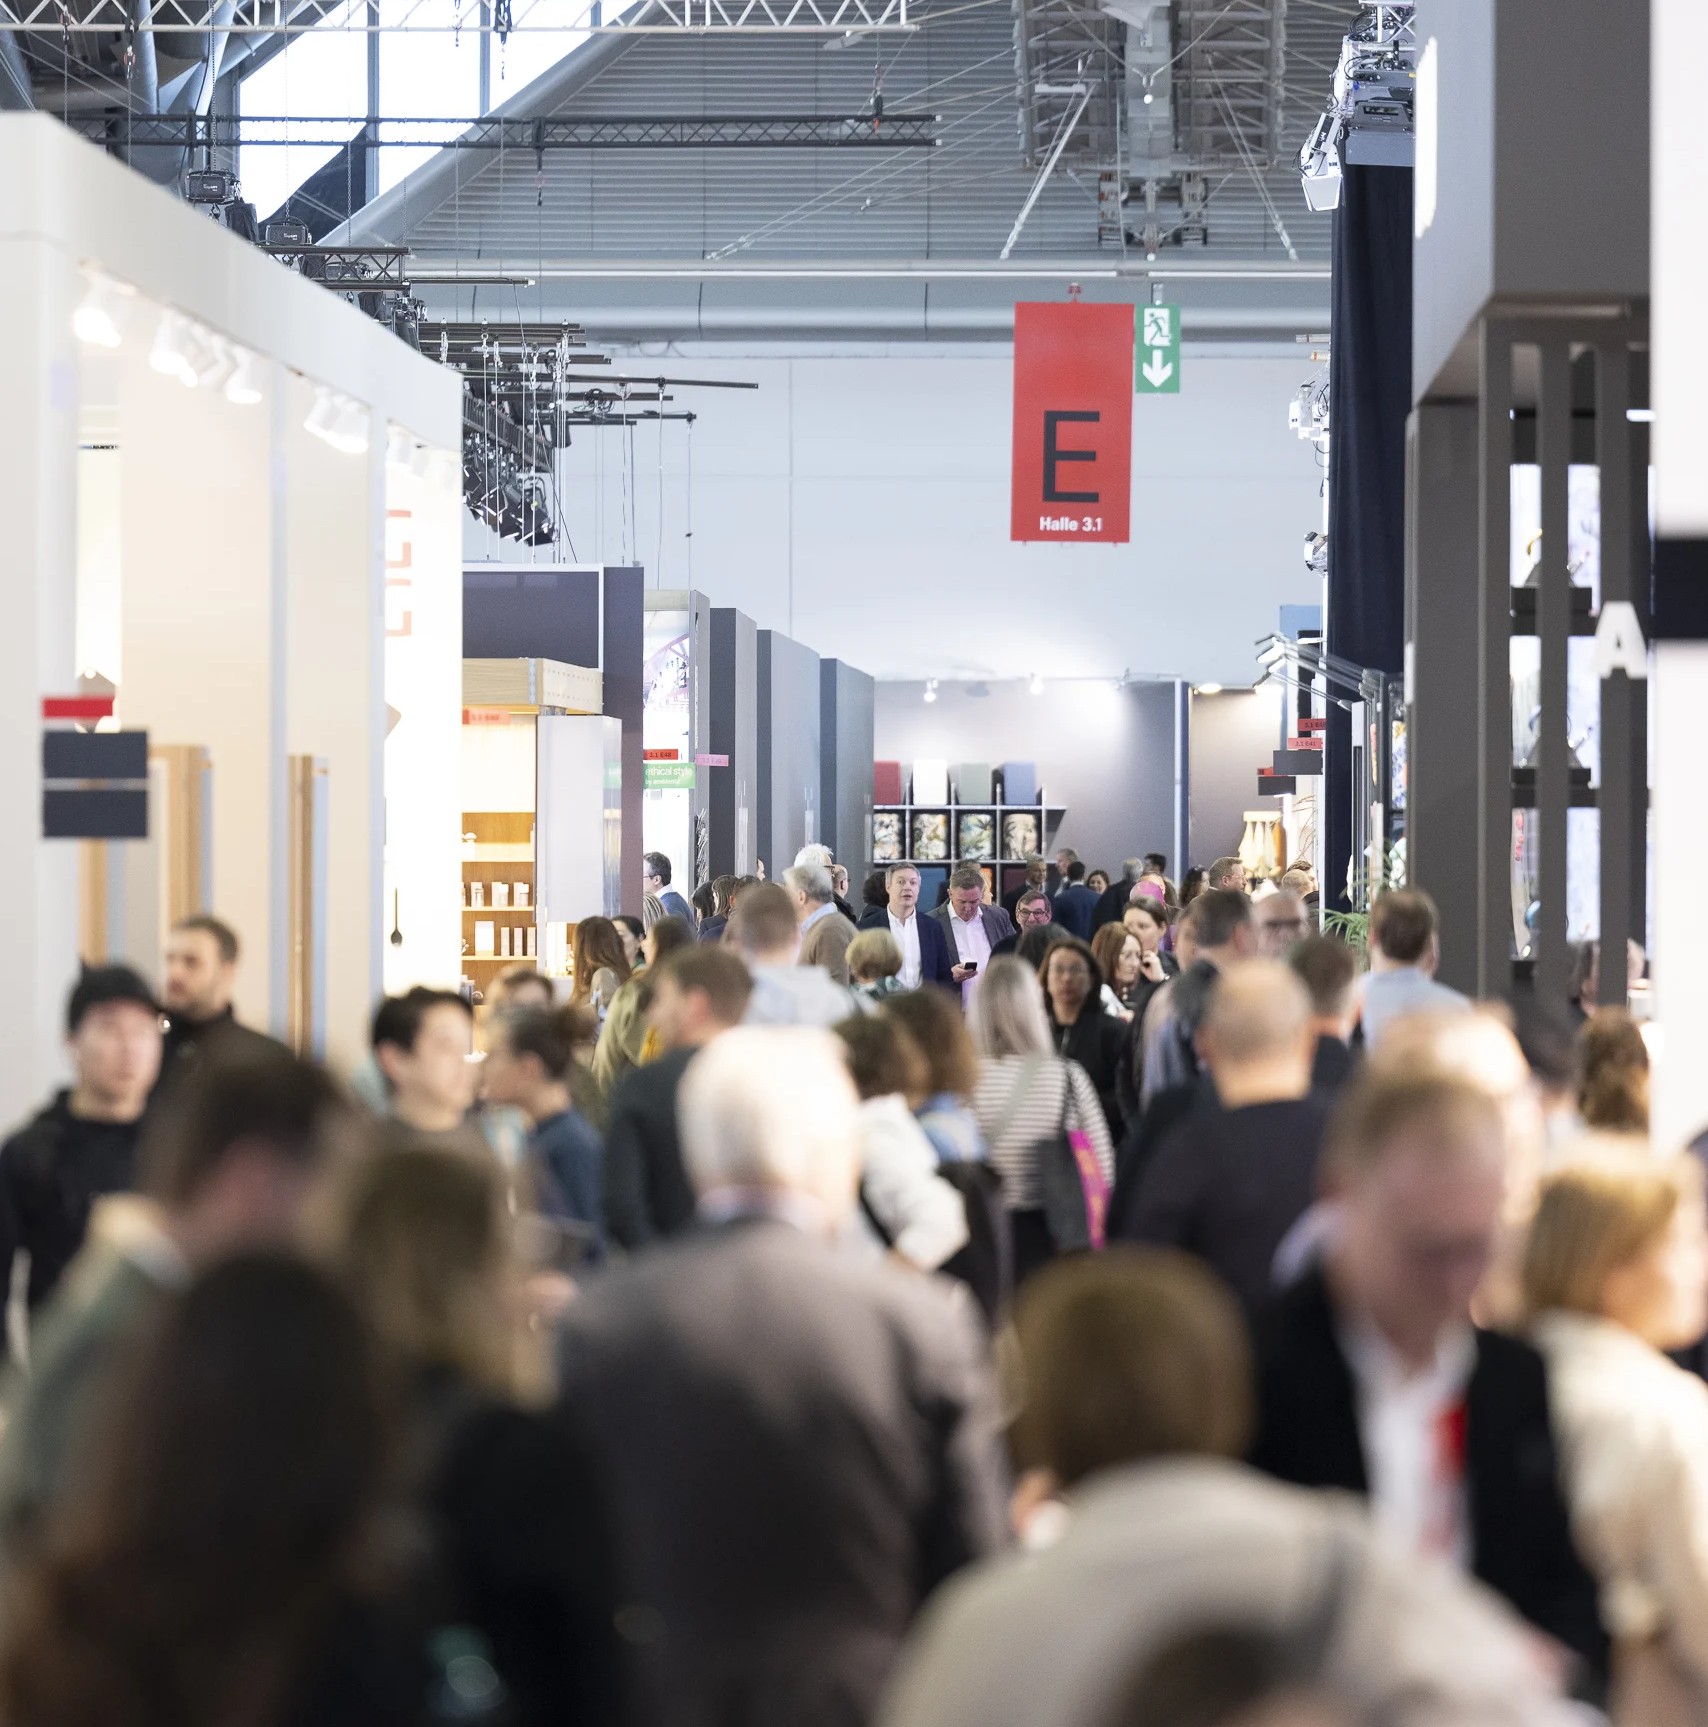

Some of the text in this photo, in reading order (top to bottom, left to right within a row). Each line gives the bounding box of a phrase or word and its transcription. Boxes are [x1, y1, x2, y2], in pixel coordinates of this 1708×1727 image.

[1042, 410, 1100, 503] E
[1039, 516, 1103, 532] Halle 3.1
[645, 767, 691, 777] ethical style
